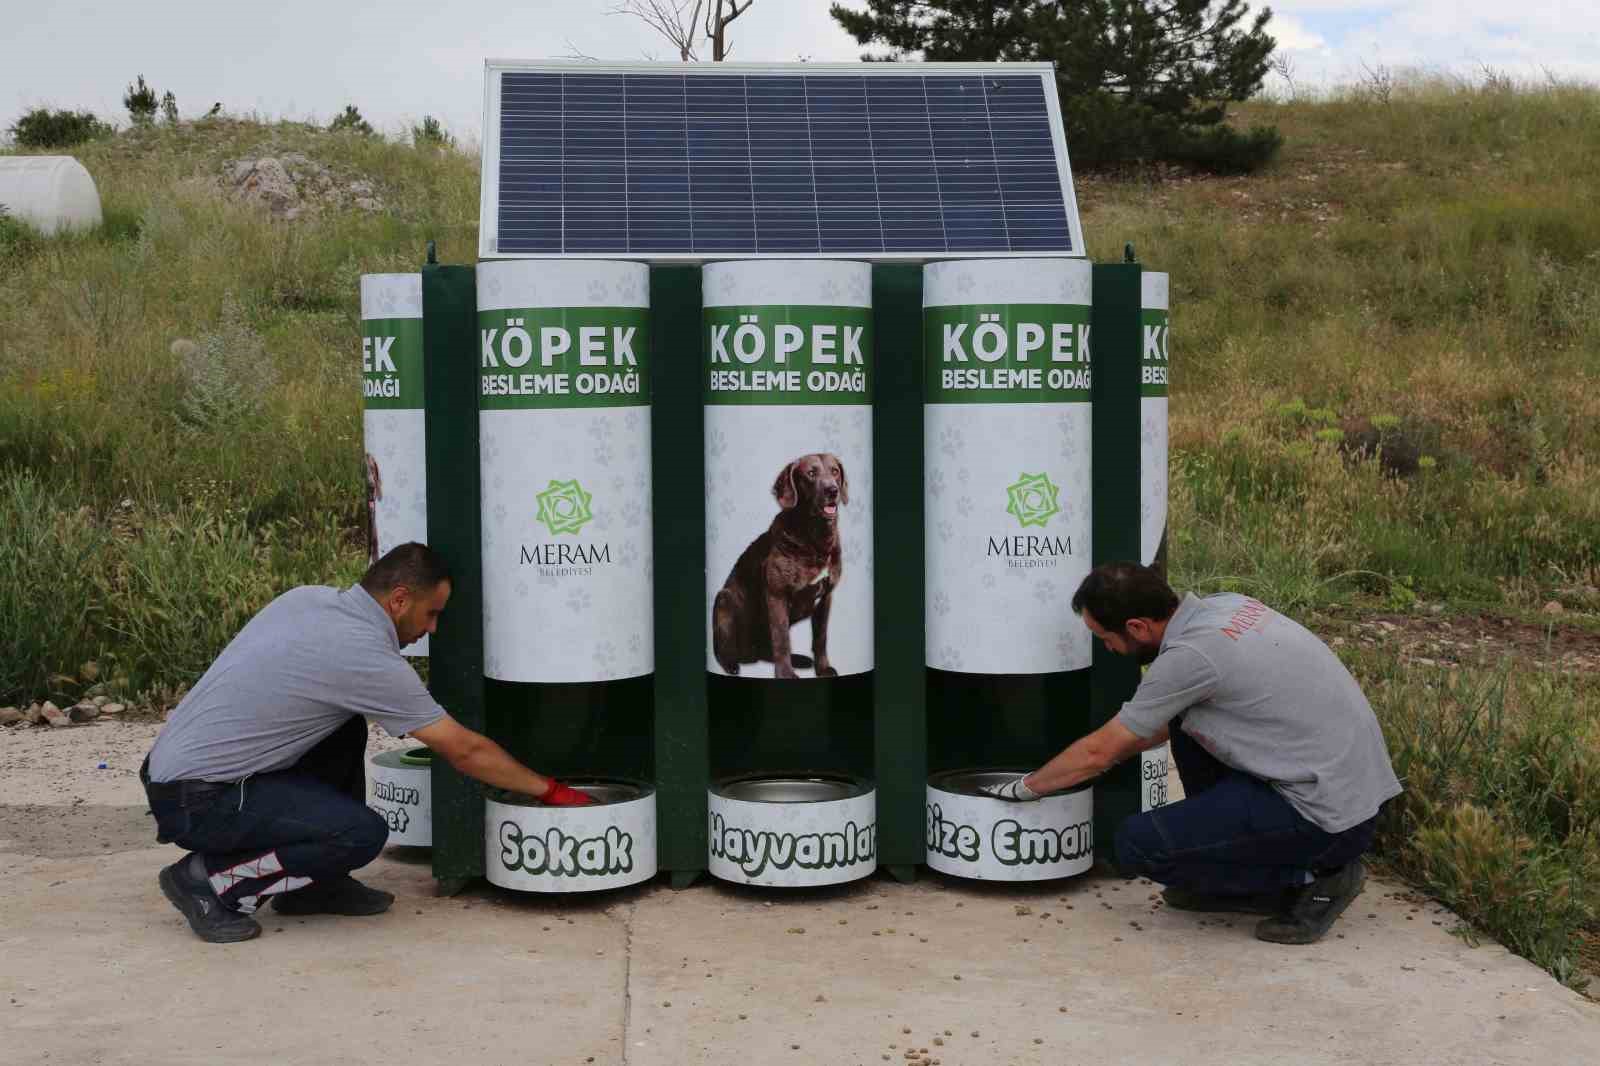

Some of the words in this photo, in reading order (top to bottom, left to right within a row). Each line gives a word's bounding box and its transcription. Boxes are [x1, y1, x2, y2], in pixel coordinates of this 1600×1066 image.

[482, 318, 637, 368] KÖPEK
[711, 315, 865, 364] KÖPEK
[943, 313, 1091, 362] KÖPEK
[363, 336, 398, 372] EK
[482, 372, 569, 396] BESLEME
[575, 368, 640, 394] ODAĞI
[710, 370, 801, 392] BESLEME
[806, 367, 866, 393] ODAĞI
[942, 368, 1042, 390] BESLEME
[520, 542, 612, 565] MERAM
[987, 535, 1073, 557] MERAM
[500, 821, 633, 877] Sokak
